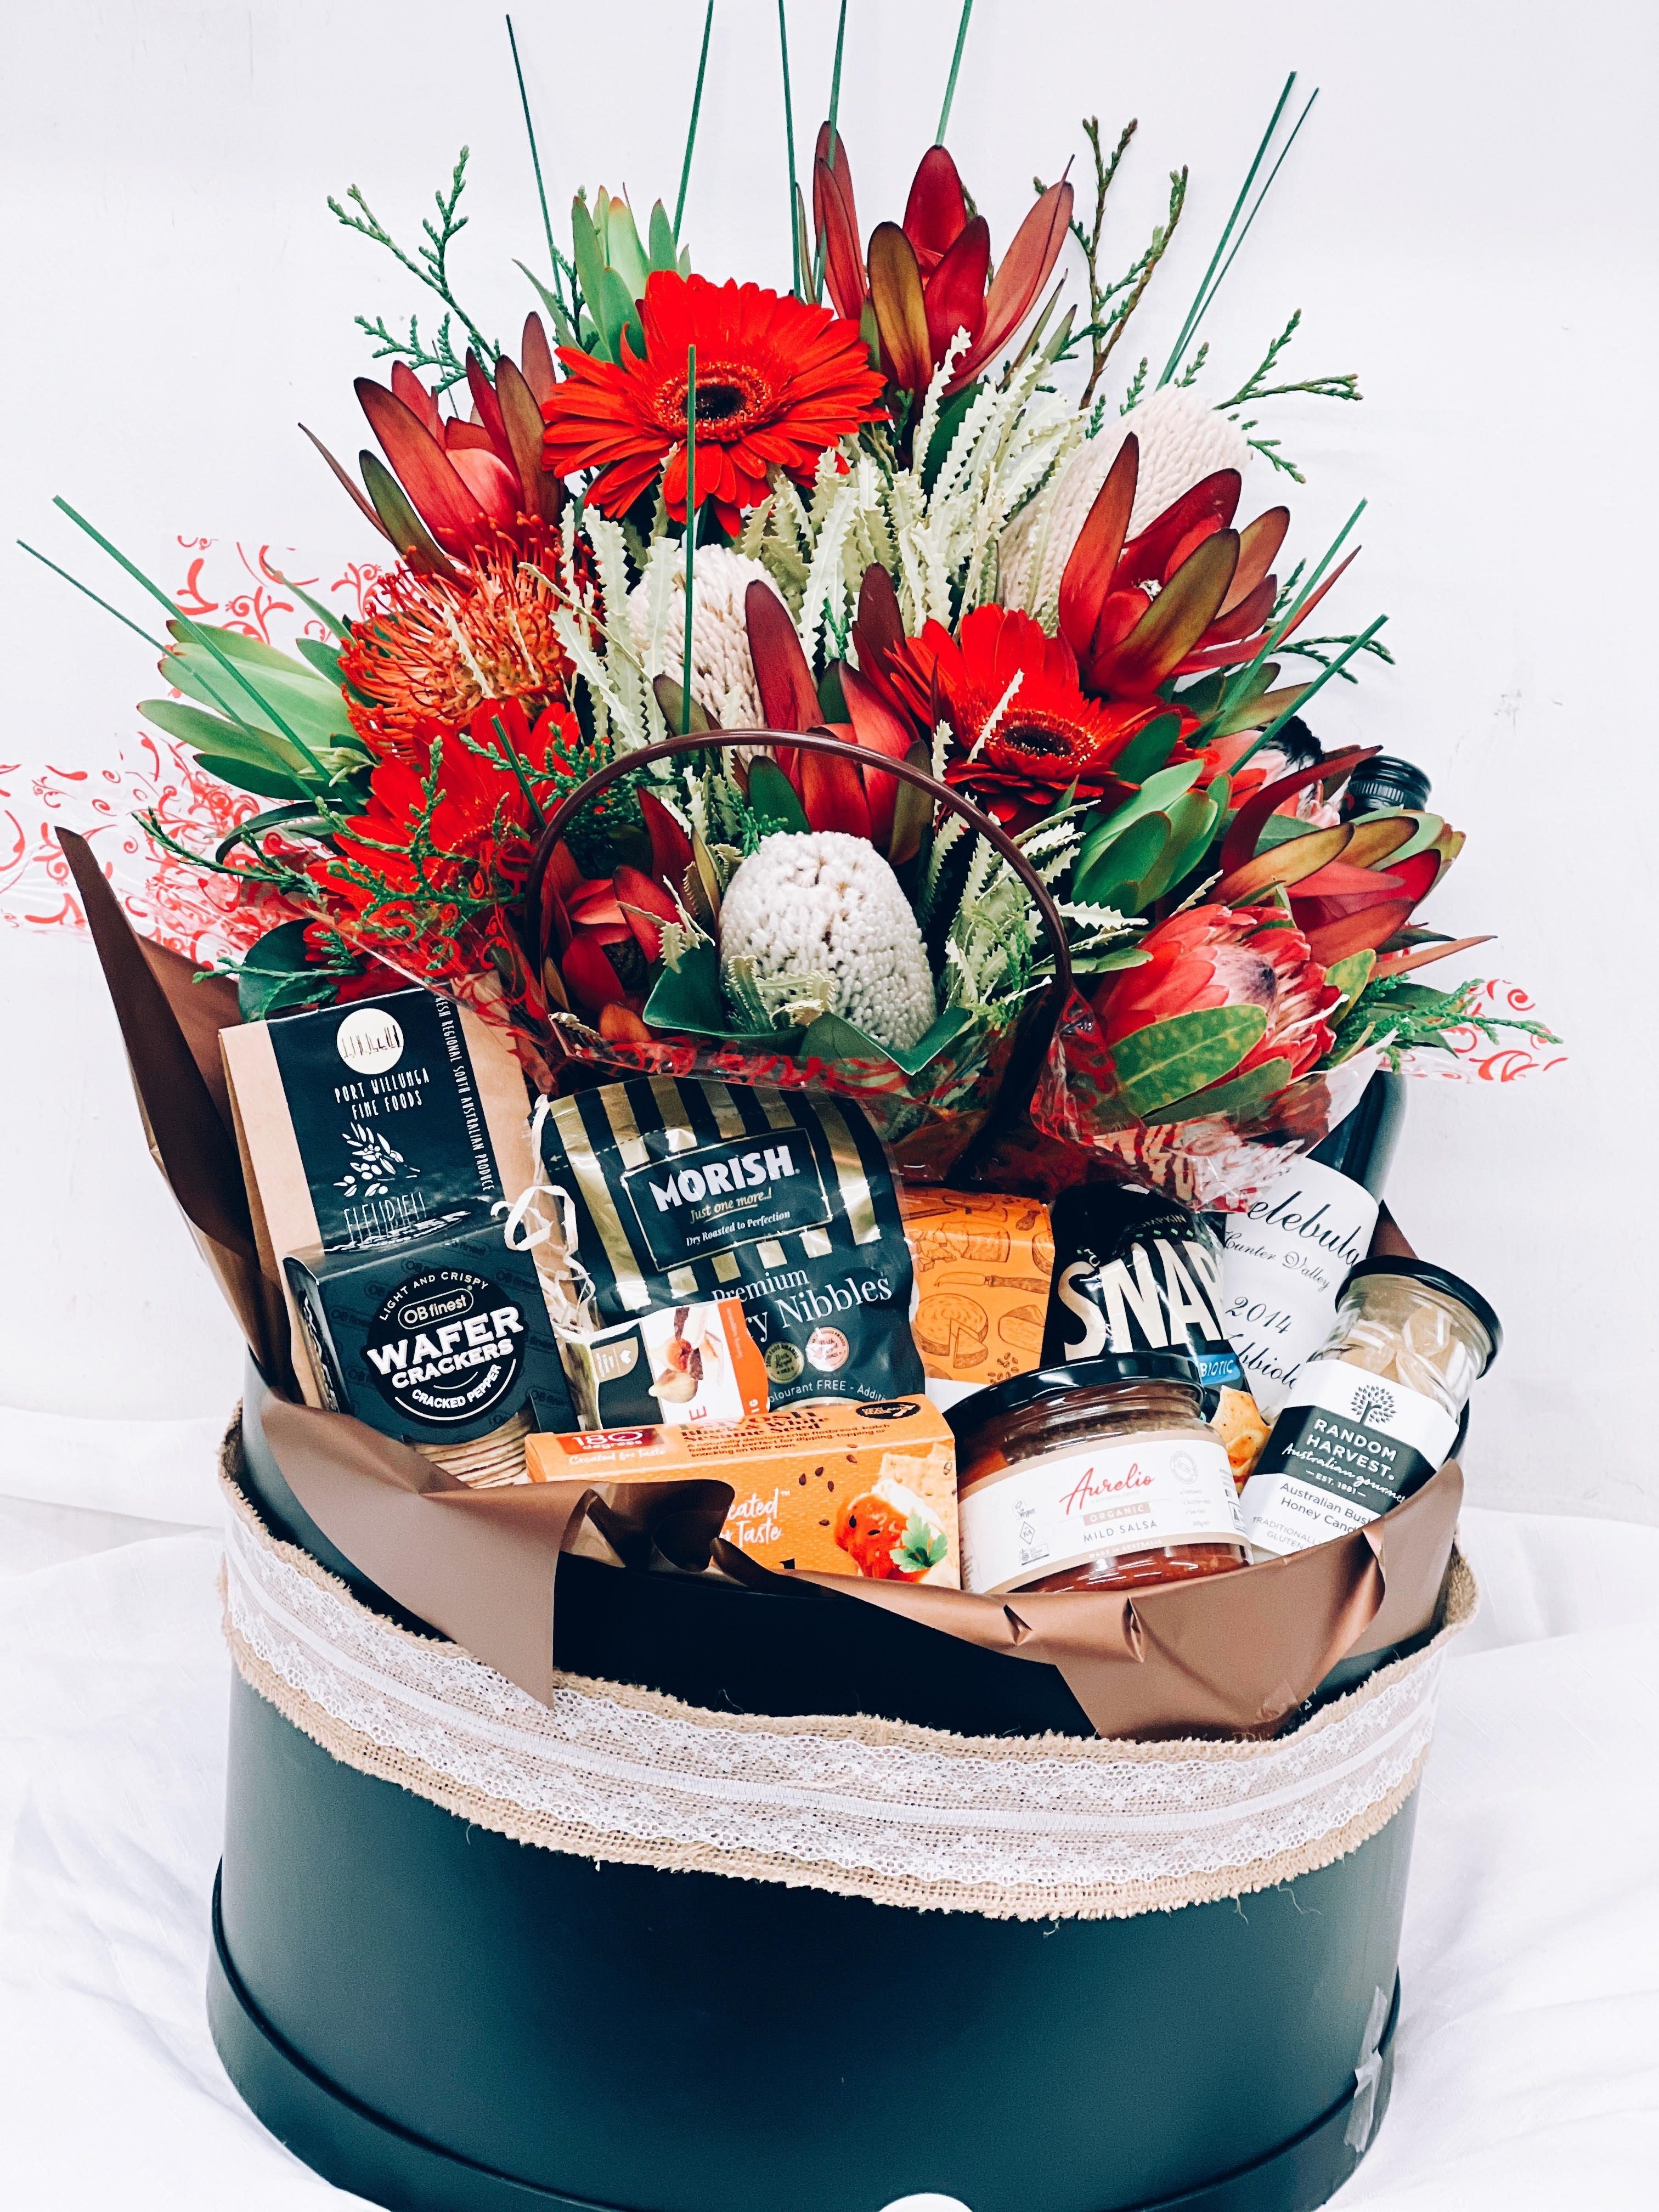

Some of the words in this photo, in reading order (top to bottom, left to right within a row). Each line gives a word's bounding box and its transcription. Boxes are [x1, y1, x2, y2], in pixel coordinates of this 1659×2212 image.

[435, 997, 451, 1017] RESH
[442, 1020, 462, 1062] REGIONAL
[334, 1082, 364, 1103] PORT
[370, 1068, 429, 1094] WILLUNGA
[453, 1065, 470, 1093] SOUTH
[352, 1100, 379, 1120] FINE
[384, 1090, 422, 1112] FOODS
[461, 1097, 484, 1150] AUSTRALIAN
[475, 1154, 494, 1191] PRODUCE
[649, 1145, 795, 1212] MORISH
[690, 1206, 712, 1224] Just
[714, 1198, 734, 1214] one
[686, 1237, 702, 1246] Dry
[702, 1222, 736, 1241] Roasted
[737, 1220, 746, 1230] to
[747, 1211, 791, 1227] Perfection
[1225, 1231, 1277, 1260] Hunter
[1282, 1251, 1330, 1292] Valley
[380, 1286, 409, 1321] LIGHT
[414, 1275, 435, 1288] AND
[441, 1272, 488, 1290] CRISPY
[711, 1269, 810, 1302] Premium
[774, 1277, 893, 1328] Nibbles
[404, 1306, 428, 1324] OB
[429, 1295, 467, 1317] finest
[1225, 1296, 1291, 1333] 2014
[367, 1306, 523, 1375] WAFER
[392, 1339, 514, 1389] CRACKERS
[412, 1389, 466, 1408] CRACKED
[466, 1364, 501, 1402] PEPPER
[769, 1381, 813, 1403] olourant
[817, 1380, 847, 1391] FREE
[572, 1431, 643, 1446] 180
[583, 1440, 643, 1450] degrees
[742, 1440, 777, 1448] perfect
[770, 1423, 821, 1433] Seed
[1314, 1419, 1397, 1462] RANDOM
[691, 1449, 734, 1458] snacking
[1282, 1443, 1356, 1477] Australian
[727, 1487, 779, 1521] eated
[1059, 1463, 1155, 1515] Aurelio
[1280, 1483, 1342, 1514] Australian
[1345, 1508, 1372, 1525] Bus
[1090, 1505, 1145, 1522] ORGANIC
[1281, 1497, 1322, 1521] Honey
[1324, 1515, 1358, 1533] Cand
[735, 1517, 783, 1549] Taste
[1084, 1528, 1114, 1543] MILD
[1120, 1520, 1158, 1533] SALSA
[1267, 1531, 1304, 1550] GLUTEN
